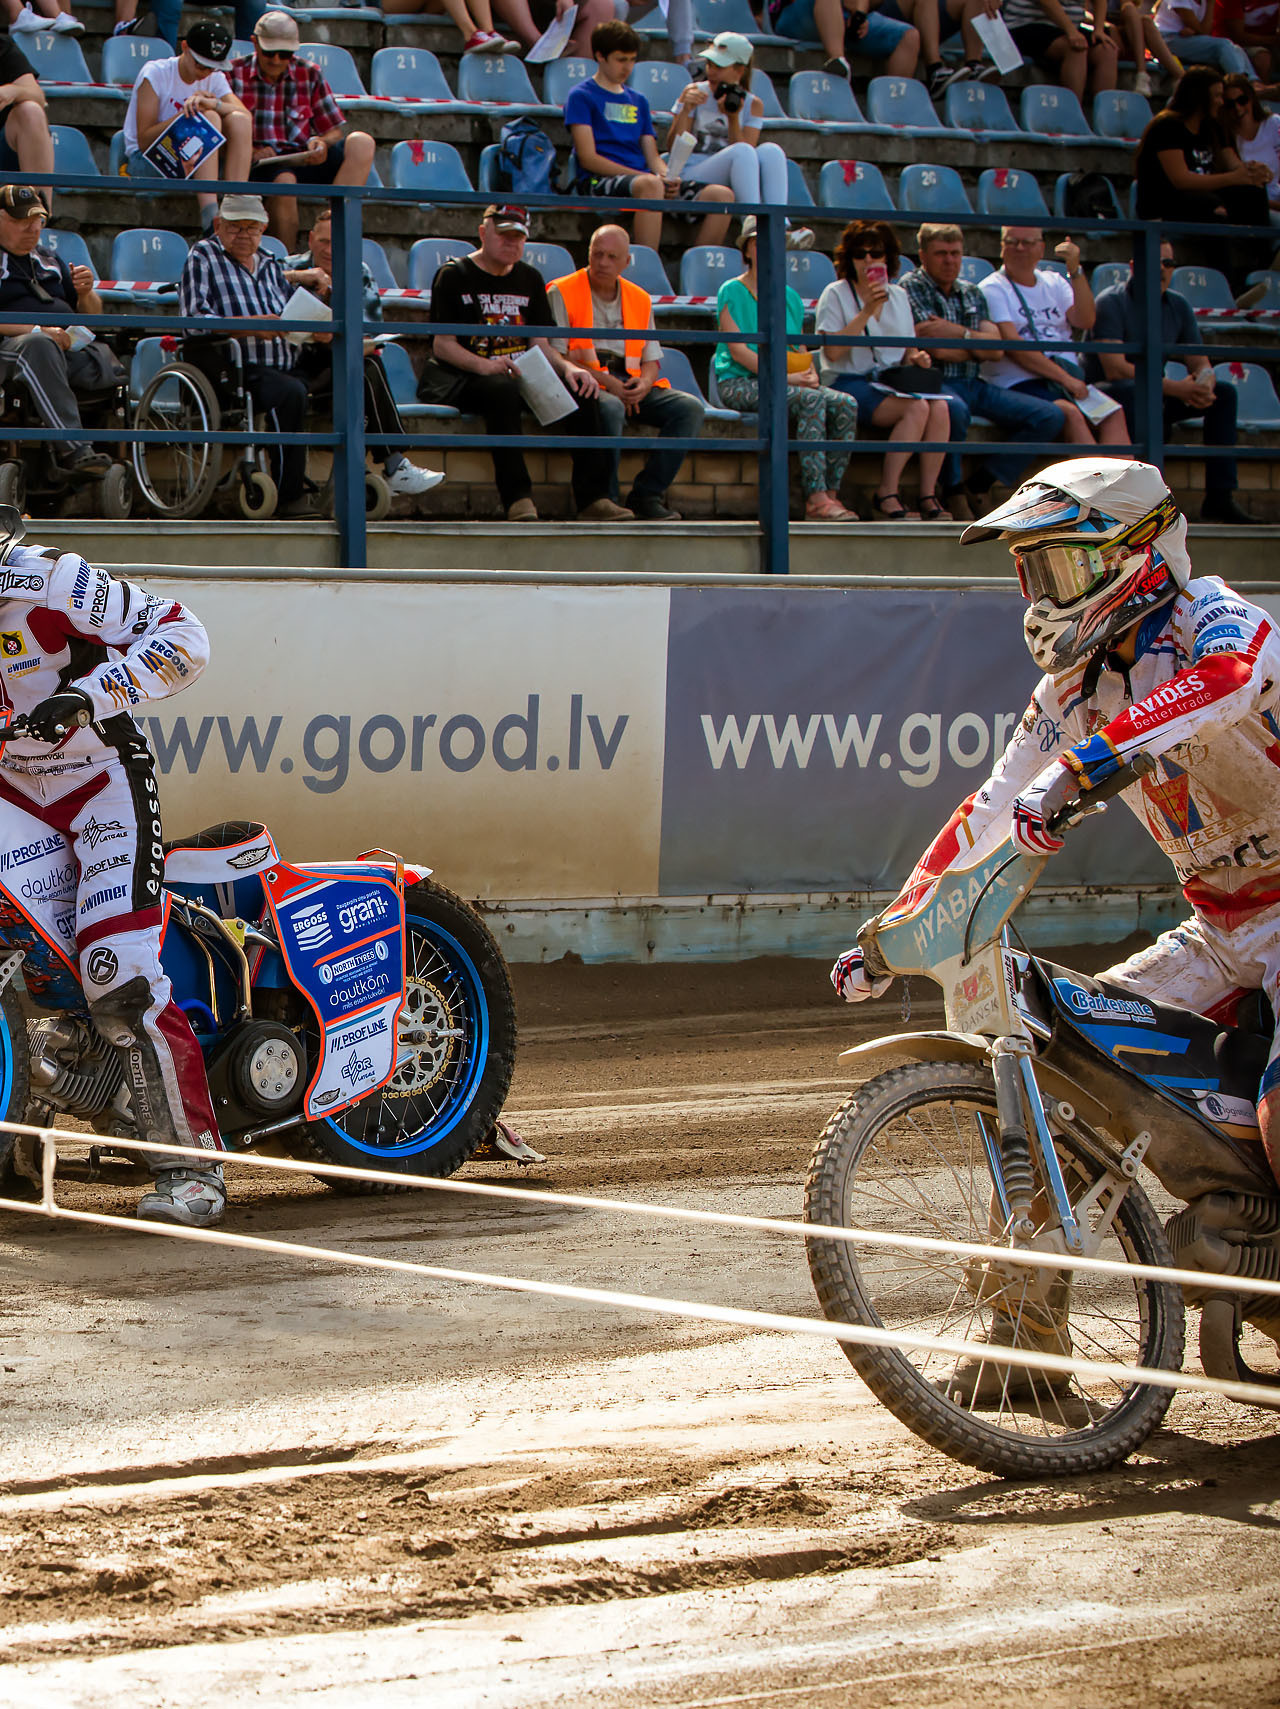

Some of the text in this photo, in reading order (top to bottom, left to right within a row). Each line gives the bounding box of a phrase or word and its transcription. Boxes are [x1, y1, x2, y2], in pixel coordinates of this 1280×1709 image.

[35, 36, 55, 50] 17
[397, 55, 417, 69] 21
[485, 59, 506, 73] 22
[567, 64, 587, 78] 23
[651, 69, 669, 83] 24
[890, 83, 907, 97] 27
[142, 238, 162, 254] 16
[706, 252, 726, 268] 22
[149, 639, 189, 678] ERGOSS
[110, 667, 140, 705] ERGOSS
[1128, 674, 1205, 722] AVIDES
[1133, 691, 1213, 730] better trade
[137, 694, 630, 794] ww.gorod.lv
[700, 711, 1016, 788] www.gor
[99, 831, 129, 843] LATGALE
[292, 911, 328, 933] ERGOSS
[333, 958, 355, 975] NORTH
[355, 950, 376, 964] TYRES
[1004, 955, 1018, 1009] products
[1077, 991, 1154, 1017] BarkerBille
[136, 1087, 154, 1127] TYRES
